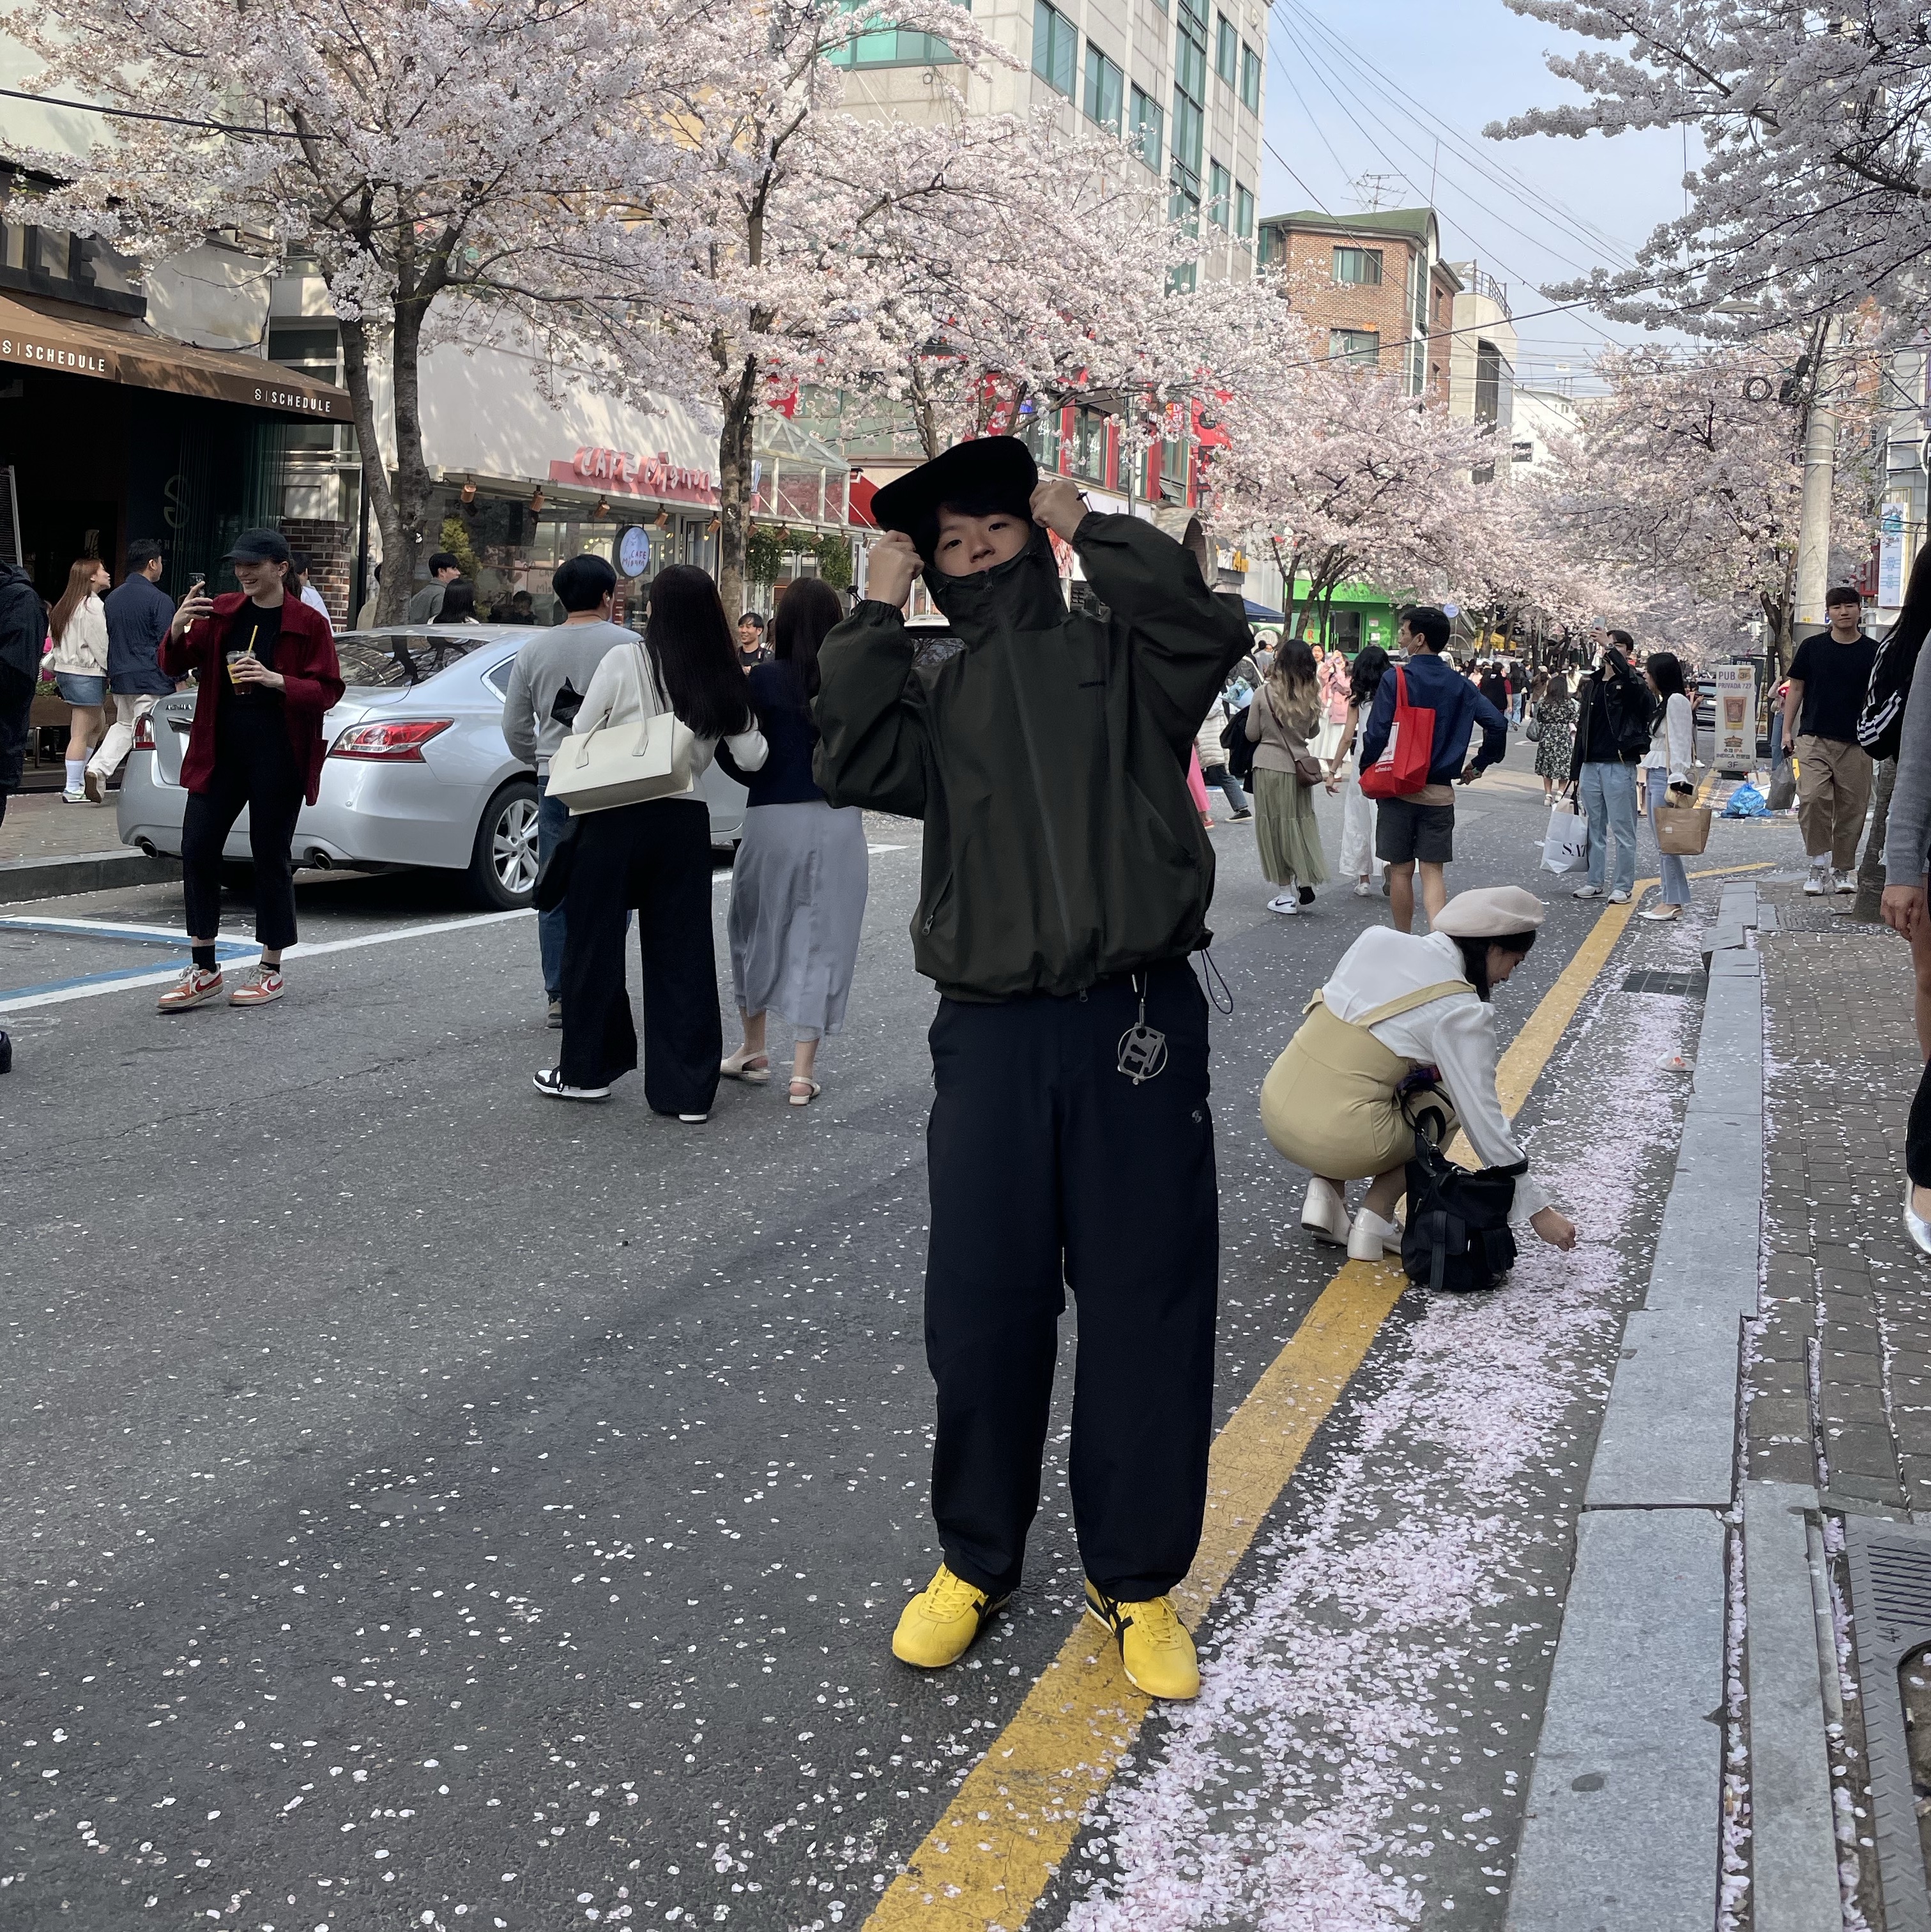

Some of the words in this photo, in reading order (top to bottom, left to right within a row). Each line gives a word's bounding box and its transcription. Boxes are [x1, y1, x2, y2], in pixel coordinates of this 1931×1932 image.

[25, 344, 105, 372] SCHEDULE
[271, 391, 331, 413] SCHEDULE
[578, 447, 636, 483] CAFE
[642, 452, 712, 492] Mignon
[630, 549, 647, 560] CAFE
[1718, 671, 1736, 680] PUB
